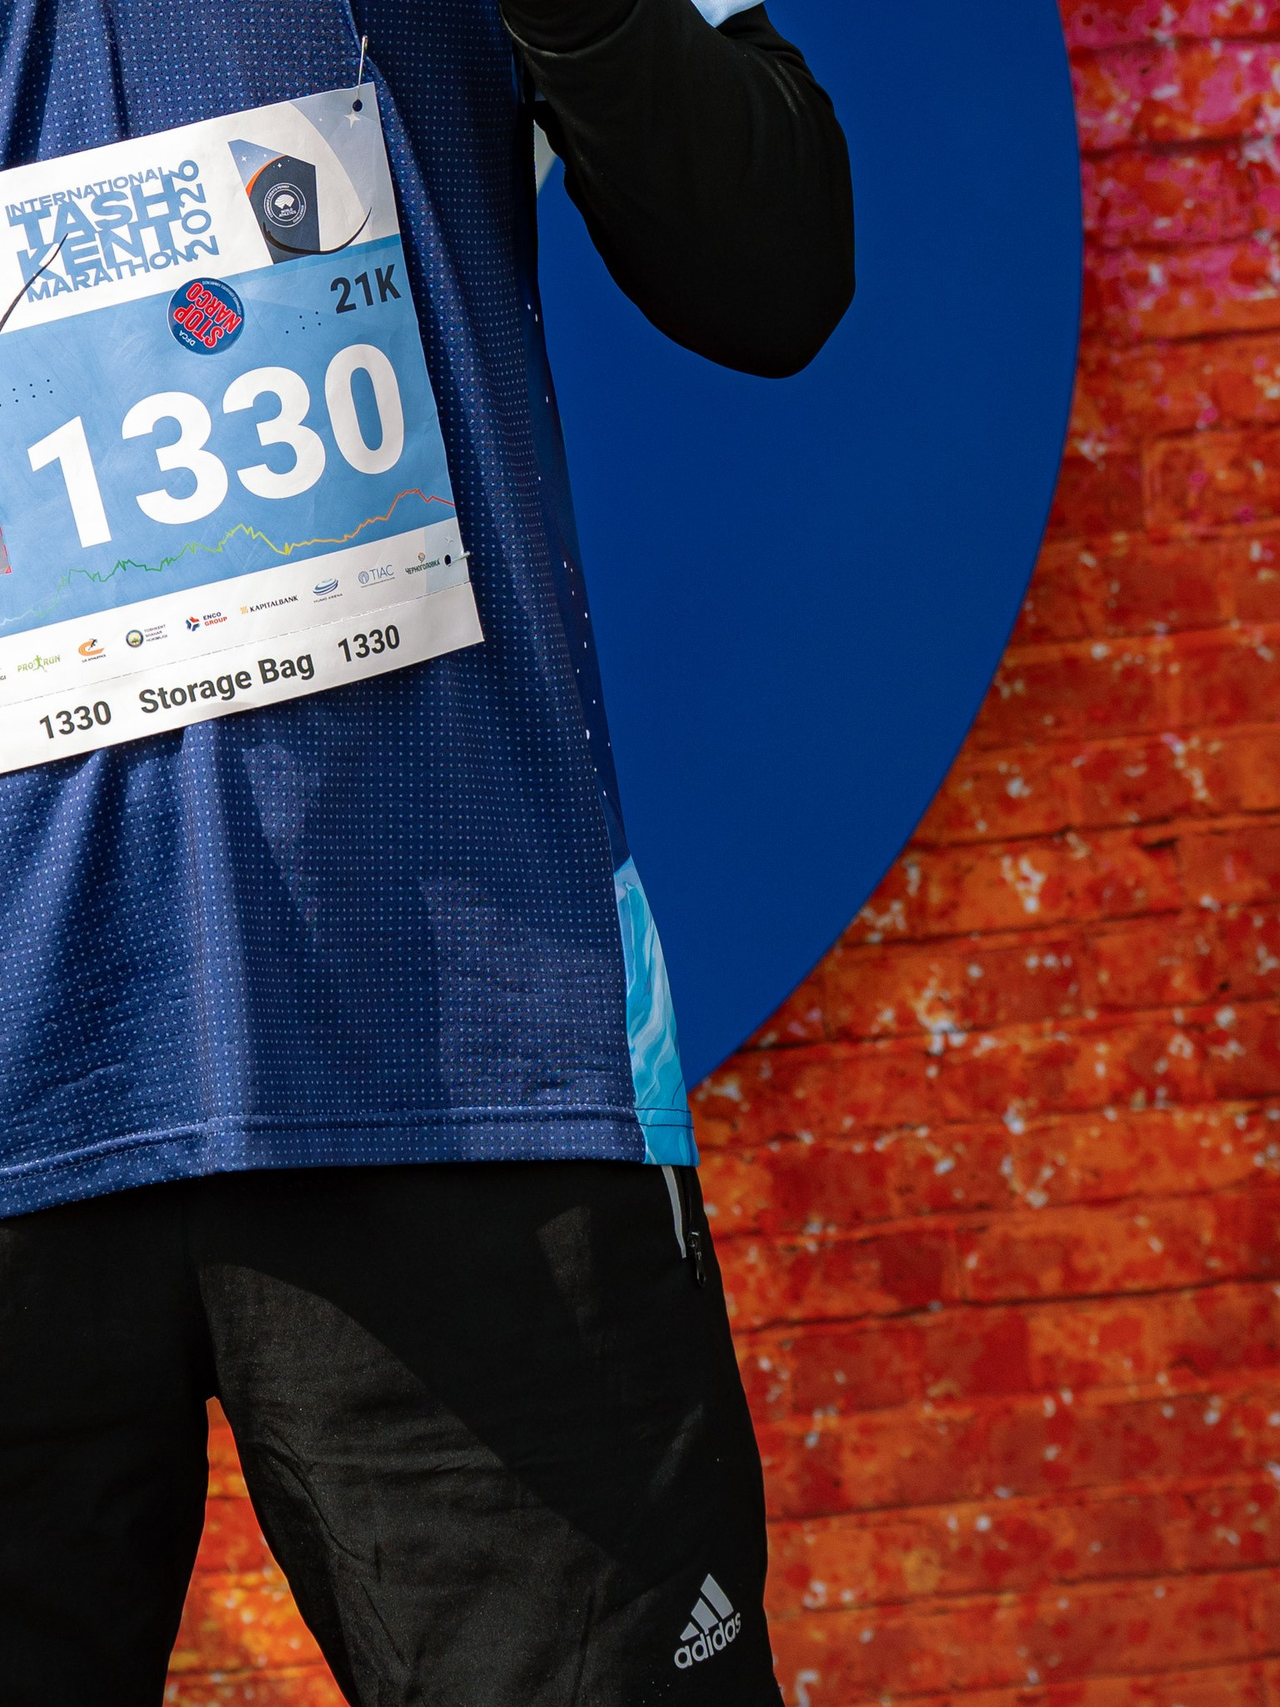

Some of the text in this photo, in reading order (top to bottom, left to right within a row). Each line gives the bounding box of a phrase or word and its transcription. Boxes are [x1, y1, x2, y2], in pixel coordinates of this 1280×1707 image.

[5, 166, 169, 218] INTERNATIONAL
[8, 173, 183, 249] TASH
[17, 218, 182, 284] KENT
[28, 249, 194, 303] MARATHON
[186, 282, 242, 333] NARCO
[330, 264, 401, 314] 21K
[173, 304, 224, 348] STOP
[28, 344, 404, 548] 1330
[369, 564, 395, 581] TIAC
[203, 611, 222, 621] ENCO
[204, 616, 228, 627] GROUP
[249, 595, 298, 613] KAPITALBANK
[17, 655, 61, 673] PRO RUN
[39, 625, 401, 740] 1330 Storage Bag 1330
[674, 1612, 741, 1669] adidas
